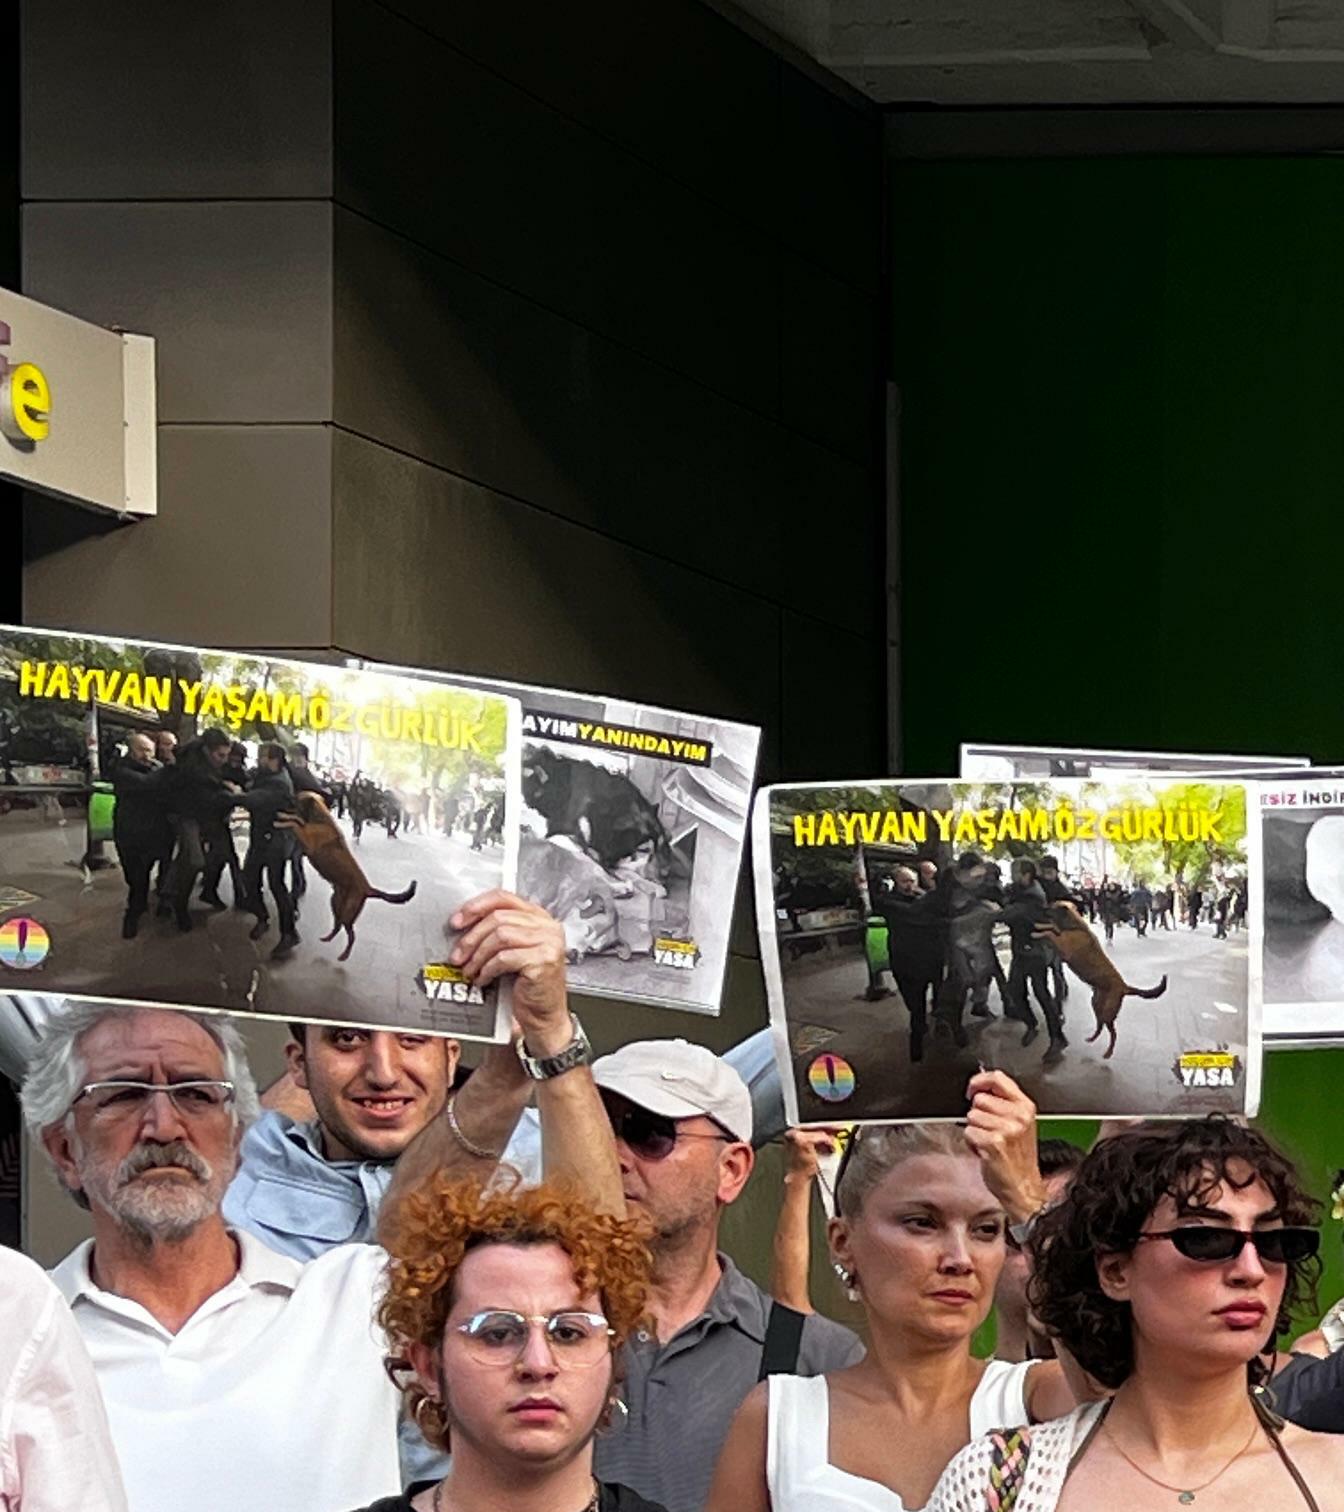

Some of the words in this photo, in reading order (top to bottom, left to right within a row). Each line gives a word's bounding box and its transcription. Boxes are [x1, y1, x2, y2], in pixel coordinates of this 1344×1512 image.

[19, 660, 172, 713] HAYVAN
[178, 678, 303, 731] YAŞAM
[793, 811, 924, 848] HAYVAN
[932, 810, 1049, 851] YAŞAM
[424, 979, 484, 1004] YASA
[1180, 1066, 1235, 1087] YASA
